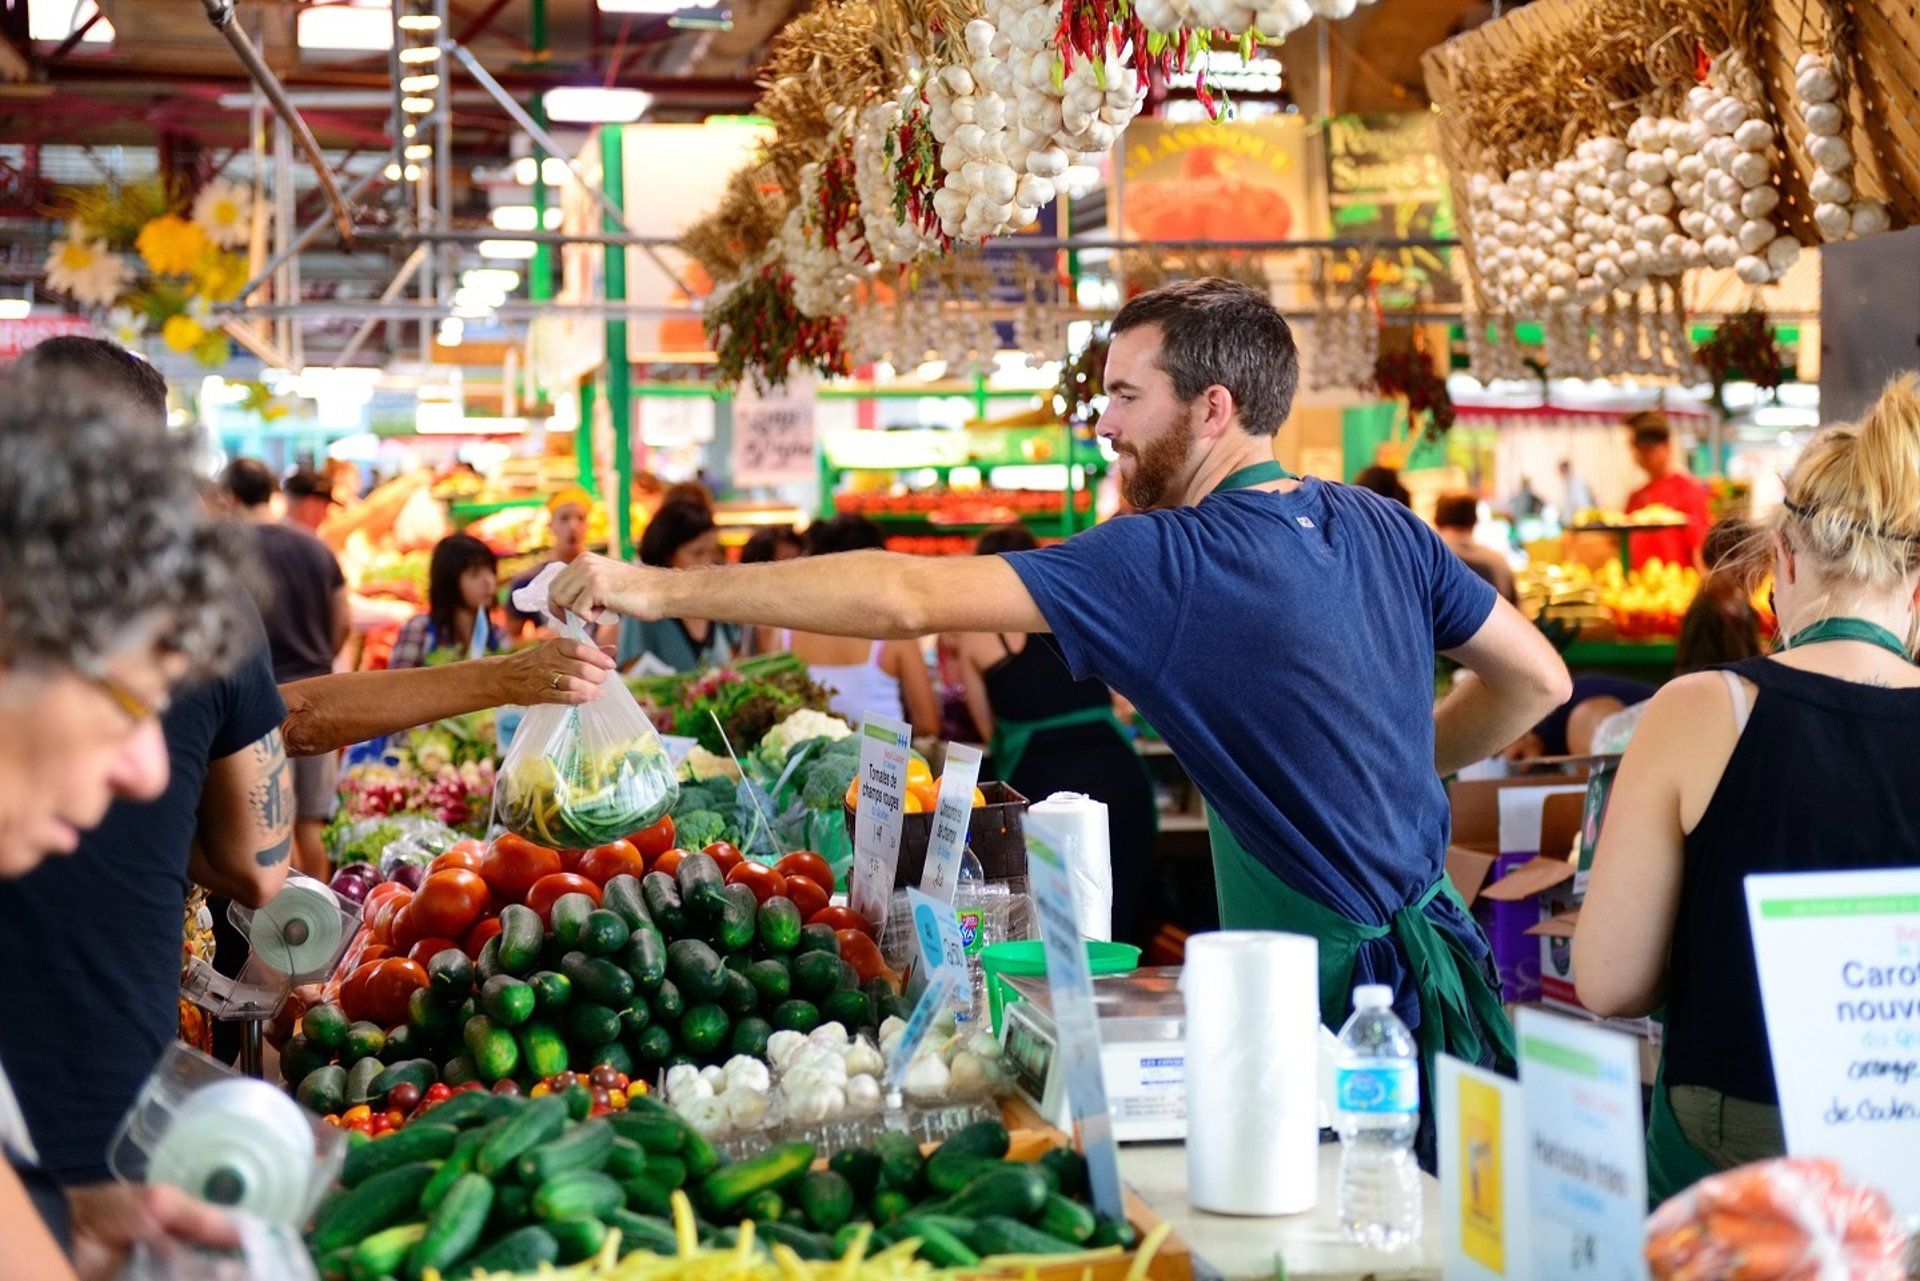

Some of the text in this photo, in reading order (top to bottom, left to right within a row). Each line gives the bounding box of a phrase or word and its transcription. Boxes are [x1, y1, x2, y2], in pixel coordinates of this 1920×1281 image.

[869, 763, 891, 787] Tomates
[862, 782, 882, 804] champs
[1837, 999, 1920, 1022] nouv
